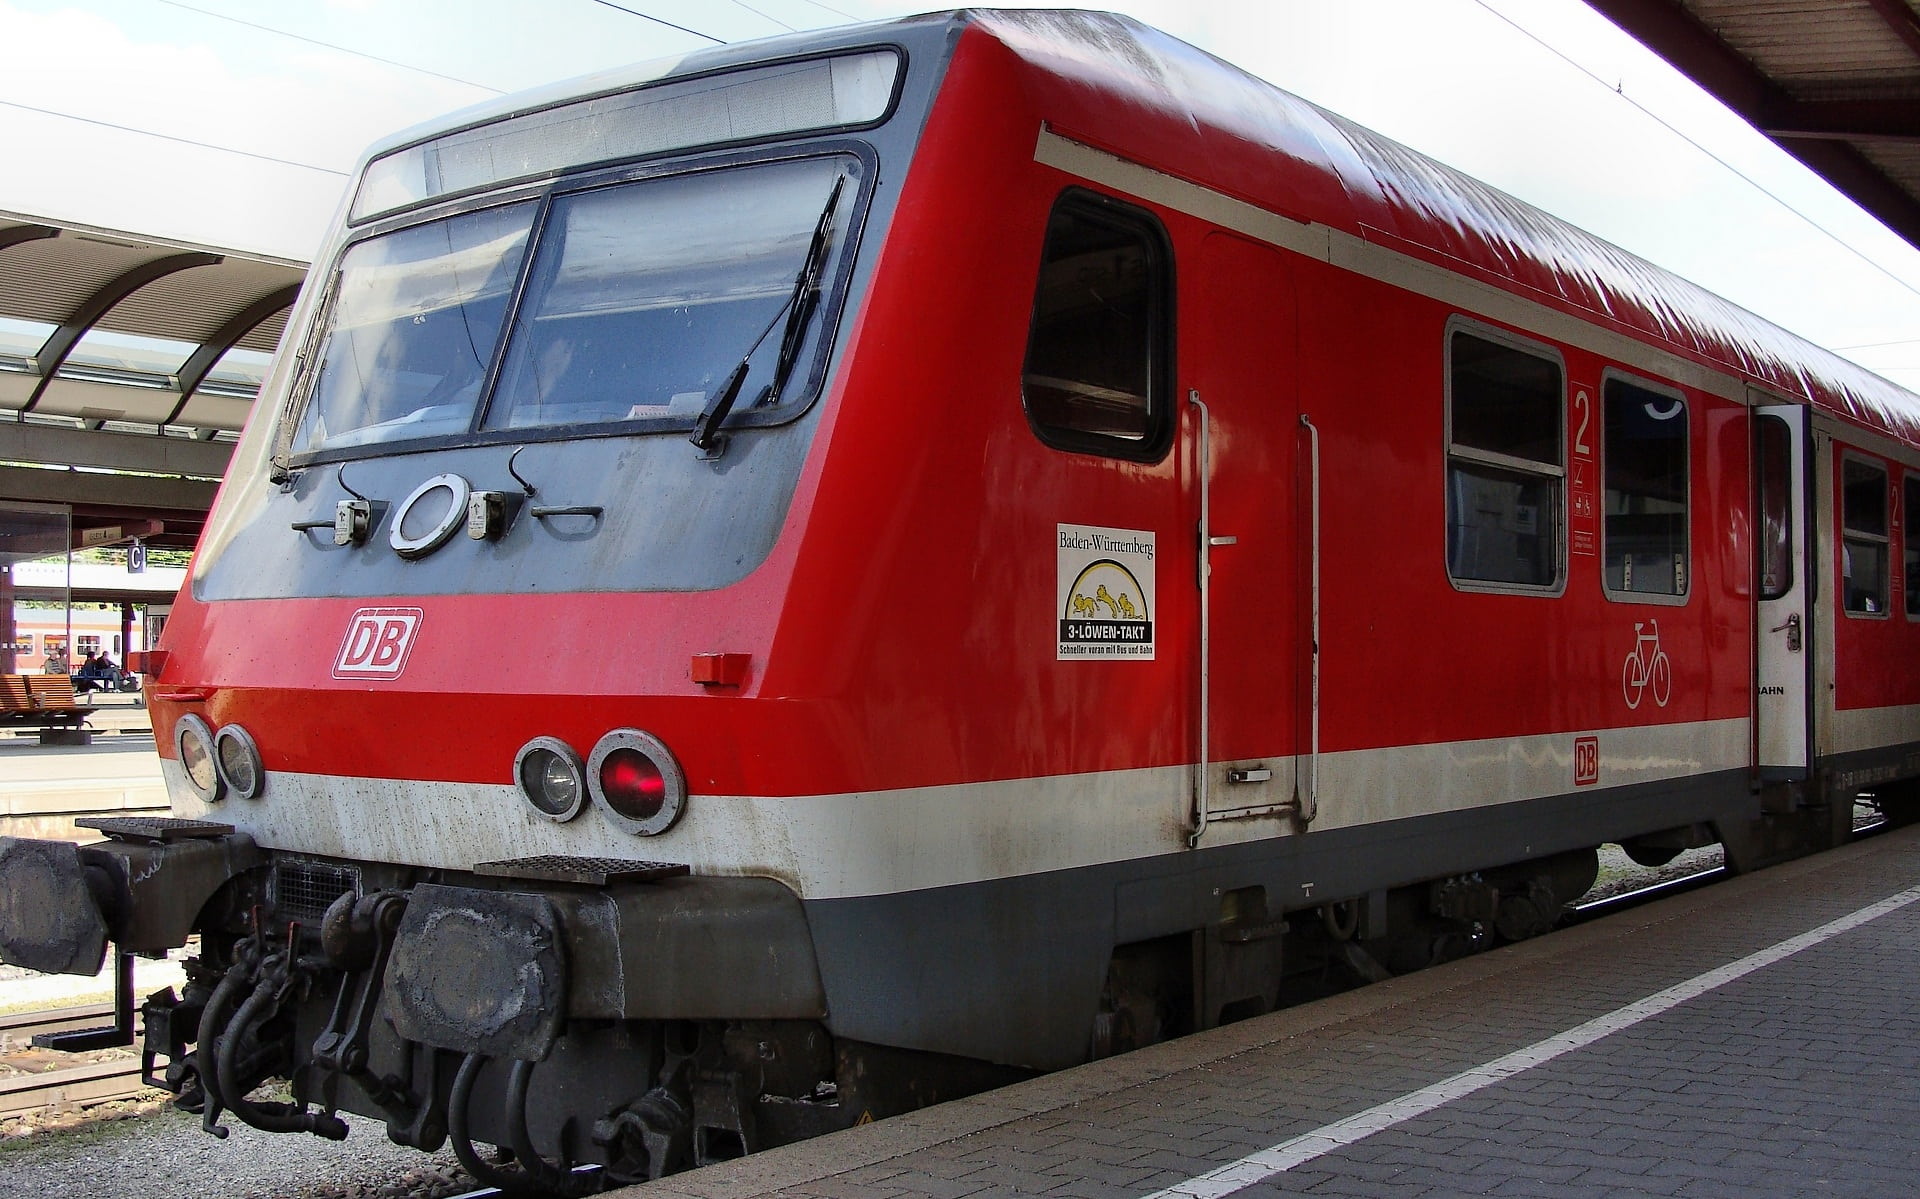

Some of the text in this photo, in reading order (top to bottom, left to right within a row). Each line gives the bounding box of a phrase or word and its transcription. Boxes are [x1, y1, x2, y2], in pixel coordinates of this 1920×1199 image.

[1575, 390, 1590, 455] 2
[1891, 485, 1899, 527] 2
[131, 547, 141, 569] C
[1060, 531, 1154, 560] Baden-Württemberg
[341, 618, 409, 668] DB
[1068, 622, 1145, 640] 3-LÖWEN-TAKT
[1060, 644, 1153, 654] Schneller voran mit Bus und Bahn
[1758, 686, 1784, 695] AHN
[1577, 743, 1596, 778] DB
